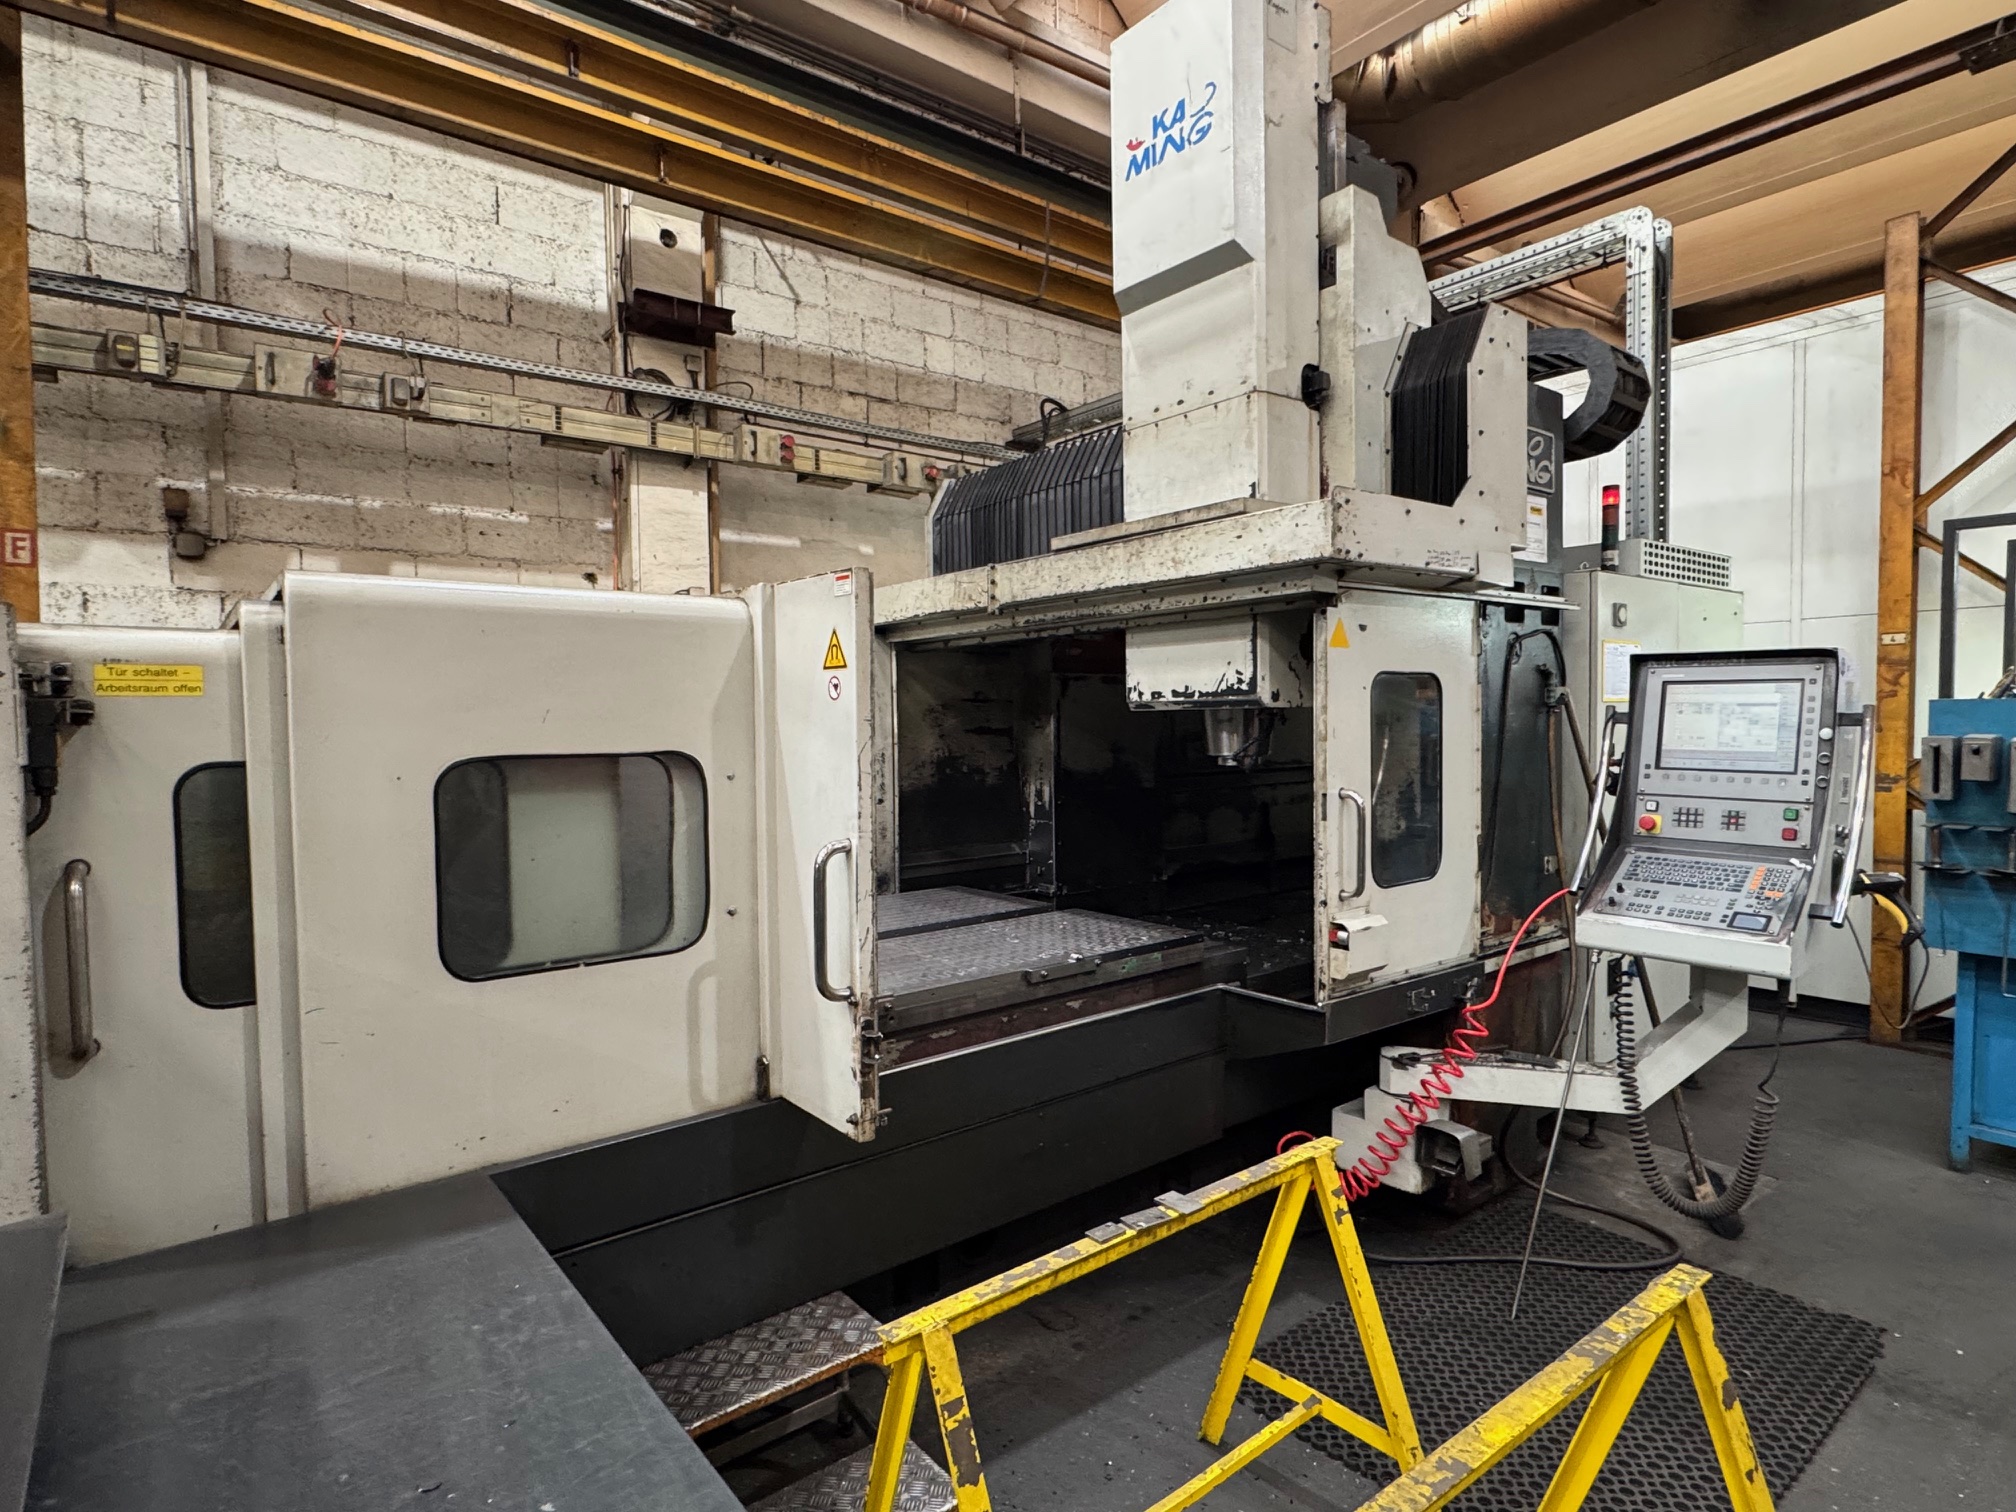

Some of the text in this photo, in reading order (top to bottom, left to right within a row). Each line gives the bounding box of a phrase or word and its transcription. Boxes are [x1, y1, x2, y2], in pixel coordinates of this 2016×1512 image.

[1125, 111, 1214, 182] MING
[107, 667, 128, 677] Tür
[132, 668, 178, 677] schaltet
[96, 684, 202, 692] Arbeitsraum offen
